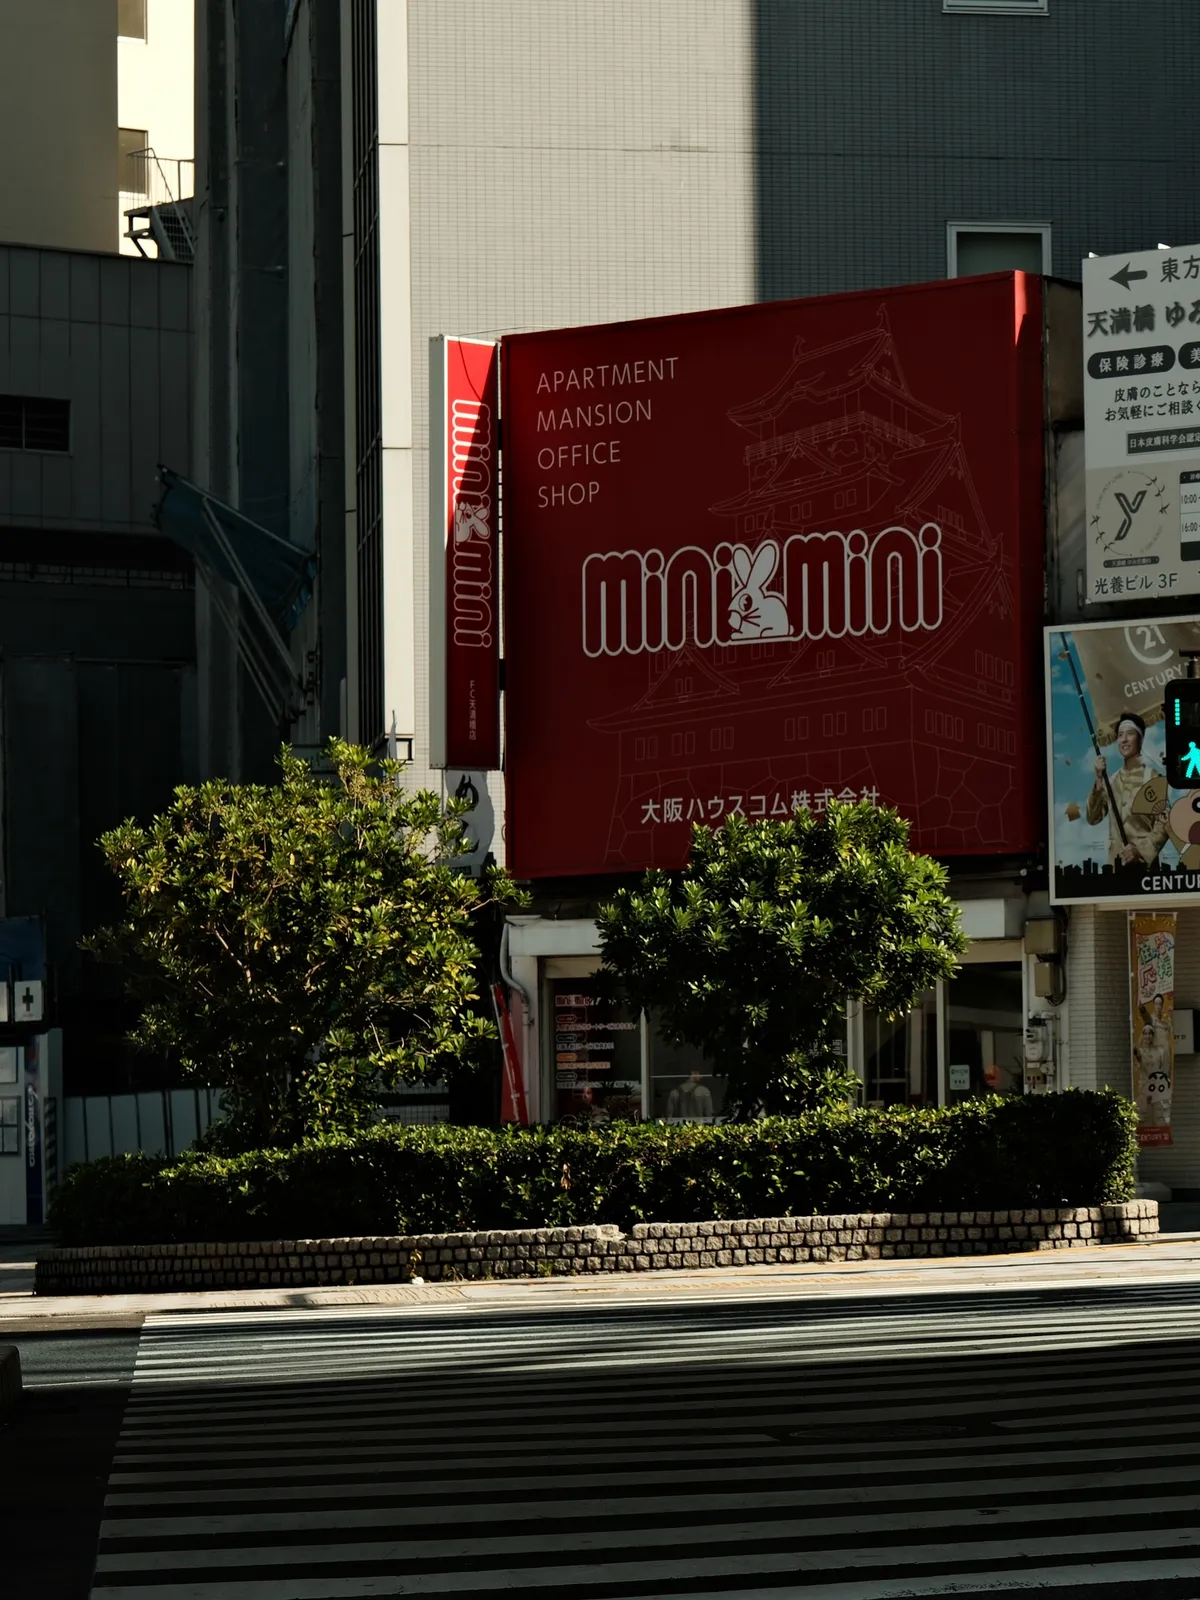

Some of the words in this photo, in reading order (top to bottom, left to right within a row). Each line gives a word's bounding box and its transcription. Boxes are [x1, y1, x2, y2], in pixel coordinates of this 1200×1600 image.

[1087, 304, 1156, 337] 天満橋
[536, 357, 679, 395] APARTMENT
[1099, 351, 1164, 373] 保険診療
[536, 400, 653, 432] MANSION
[538, 441, 622, 470] OFFICE
[538, 482, 600, 508] SHOP
[582, 542, 735, 658] mini
[783, 522, 943, 641] mini
[1094, 574, 1153, 595] 光養ビル
[1158, 573, 1178, 589] 3F
[1124, 664, 1183, 698] CENTURY
[641, 785, 881, 824] 大阪ハウスコム株式会社
